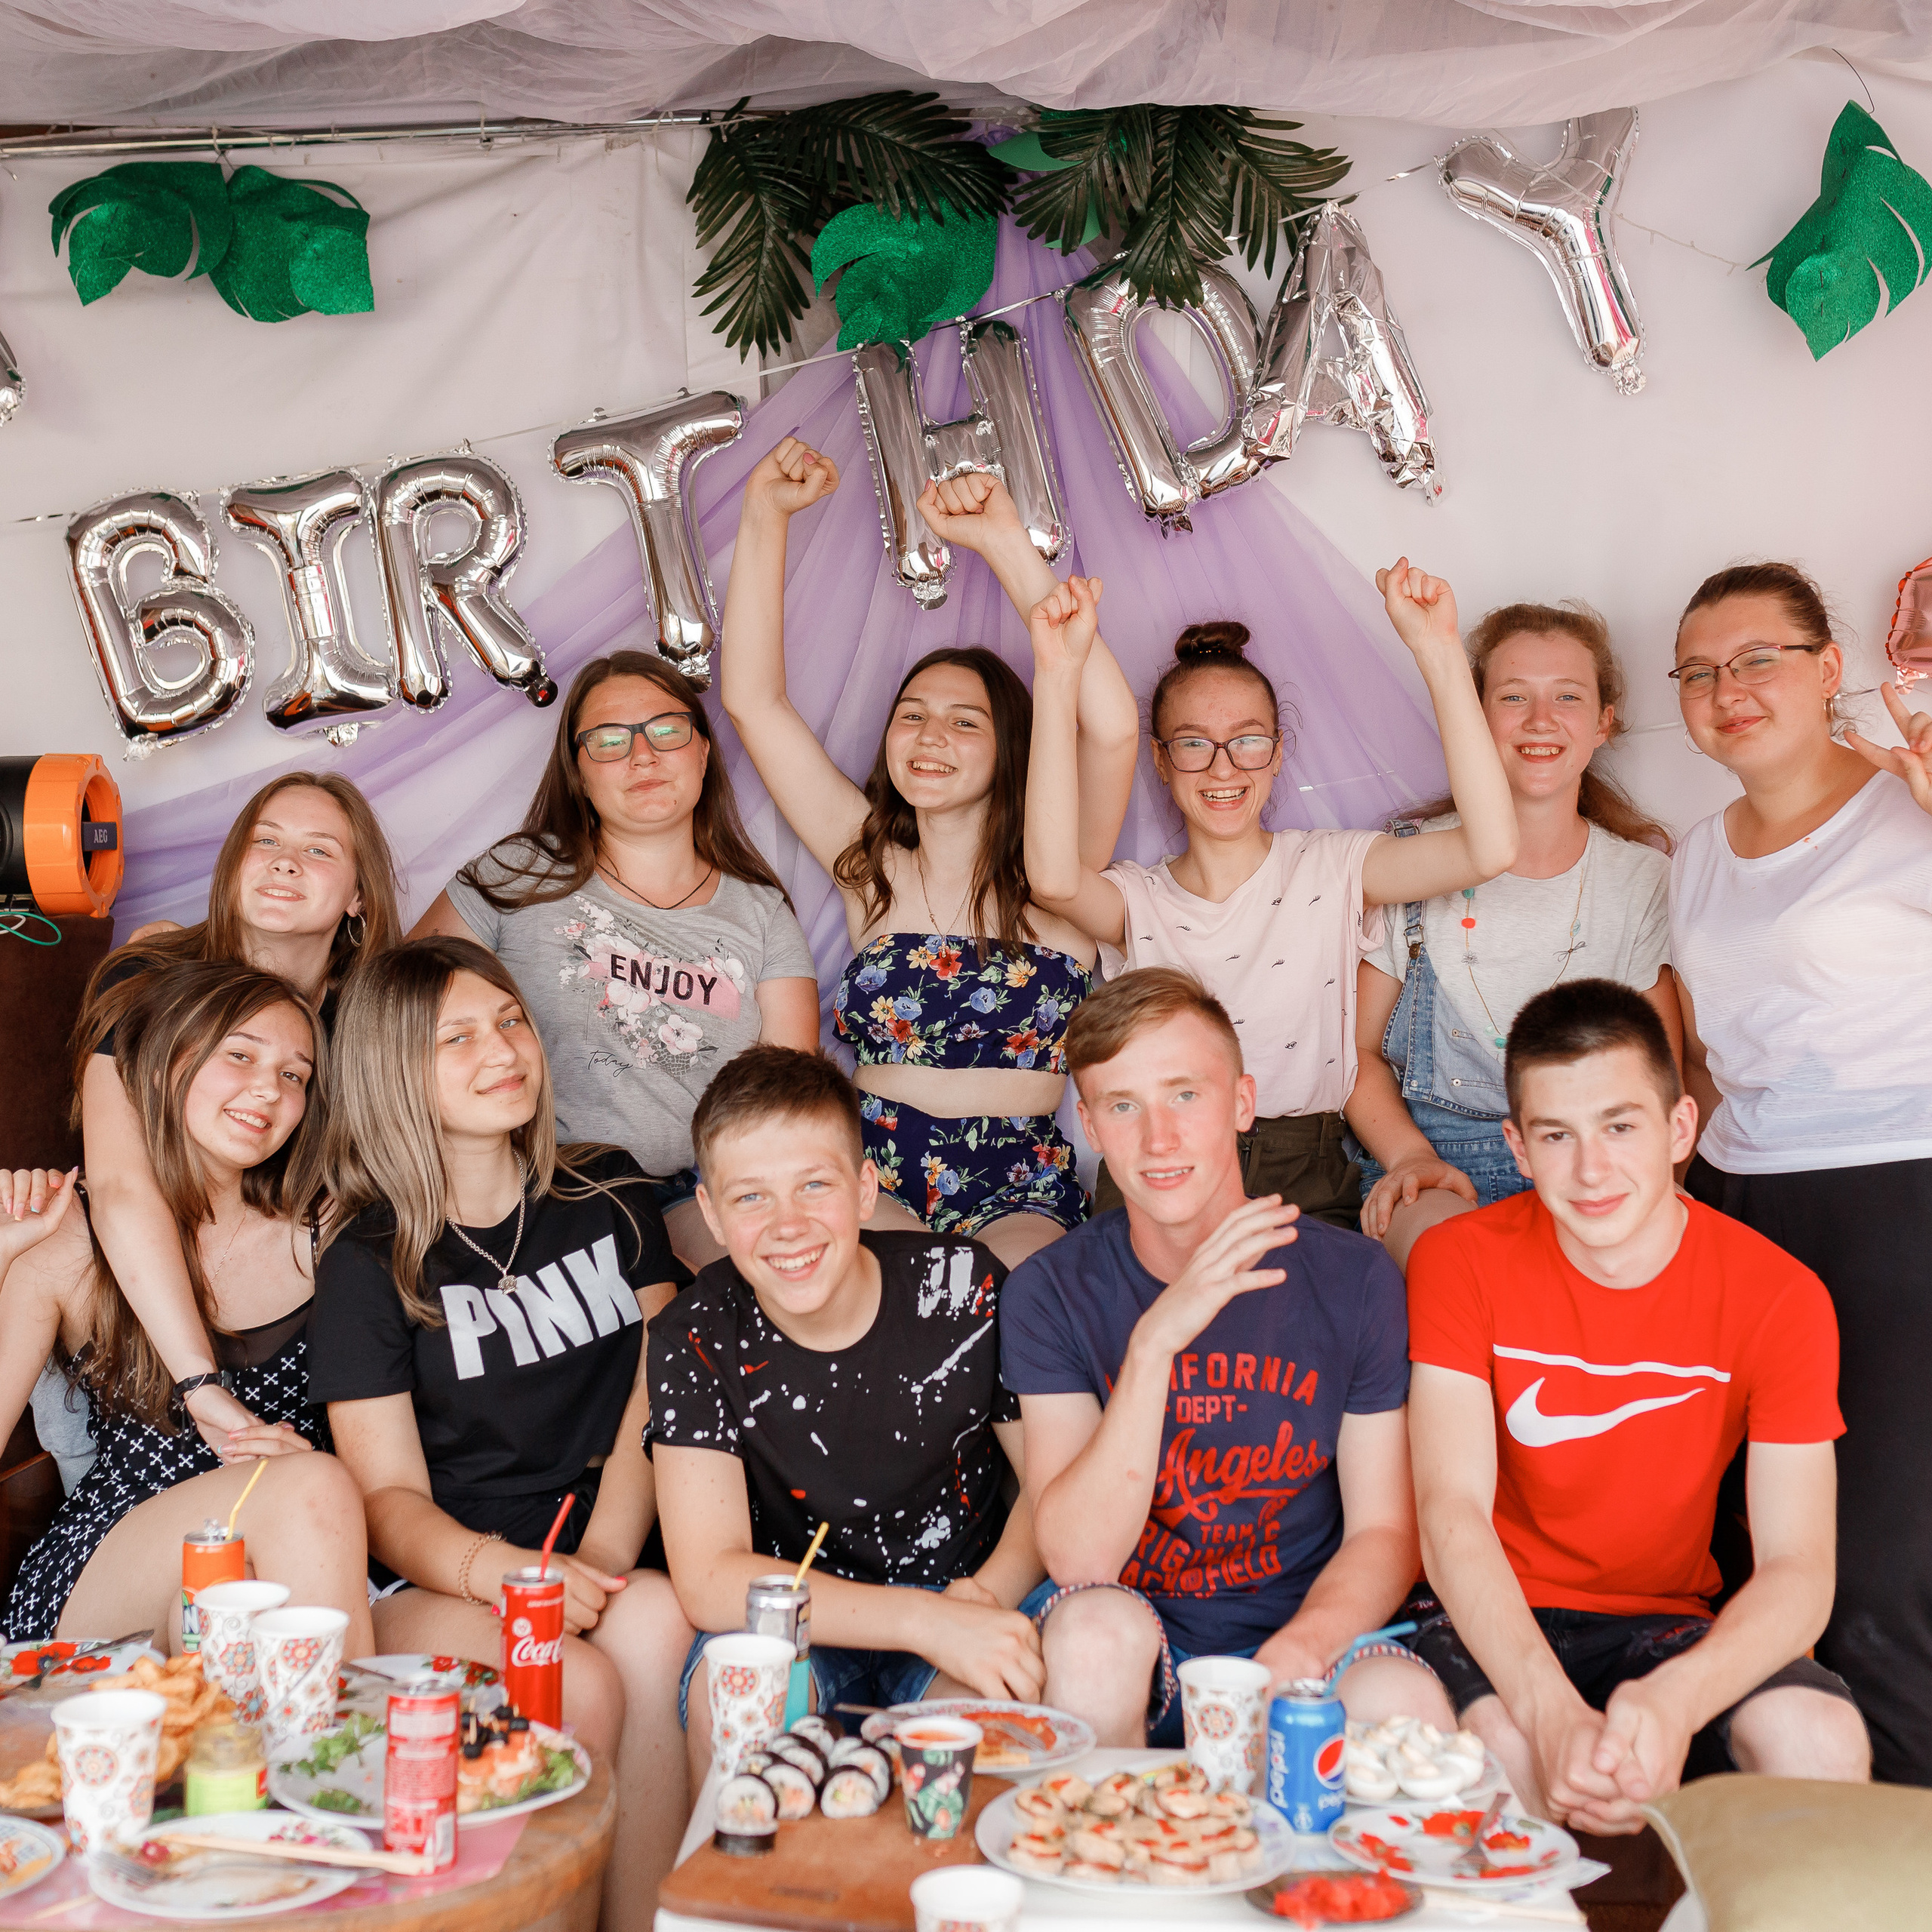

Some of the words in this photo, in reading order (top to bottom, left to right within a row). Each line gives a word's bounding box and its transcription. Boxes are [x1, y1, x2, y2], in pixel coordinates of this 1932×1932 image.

[65, 106, 1647, 755] BIRTHDAY
[93, 829, 108, 844] AEG
[610, 953, 718, 1006] ENJOY
[588, 1049, 633, 1078] Today
[439, 1233, 643, 1380] PINK
[1105, 1352, 1319, 1406] IFORNIA
[1150, 1420, 1329, 1515] Angeles
[1200, 1524, 1254, 1545] TEAM
[1205, 1544, 1282, 1591] FIELD
